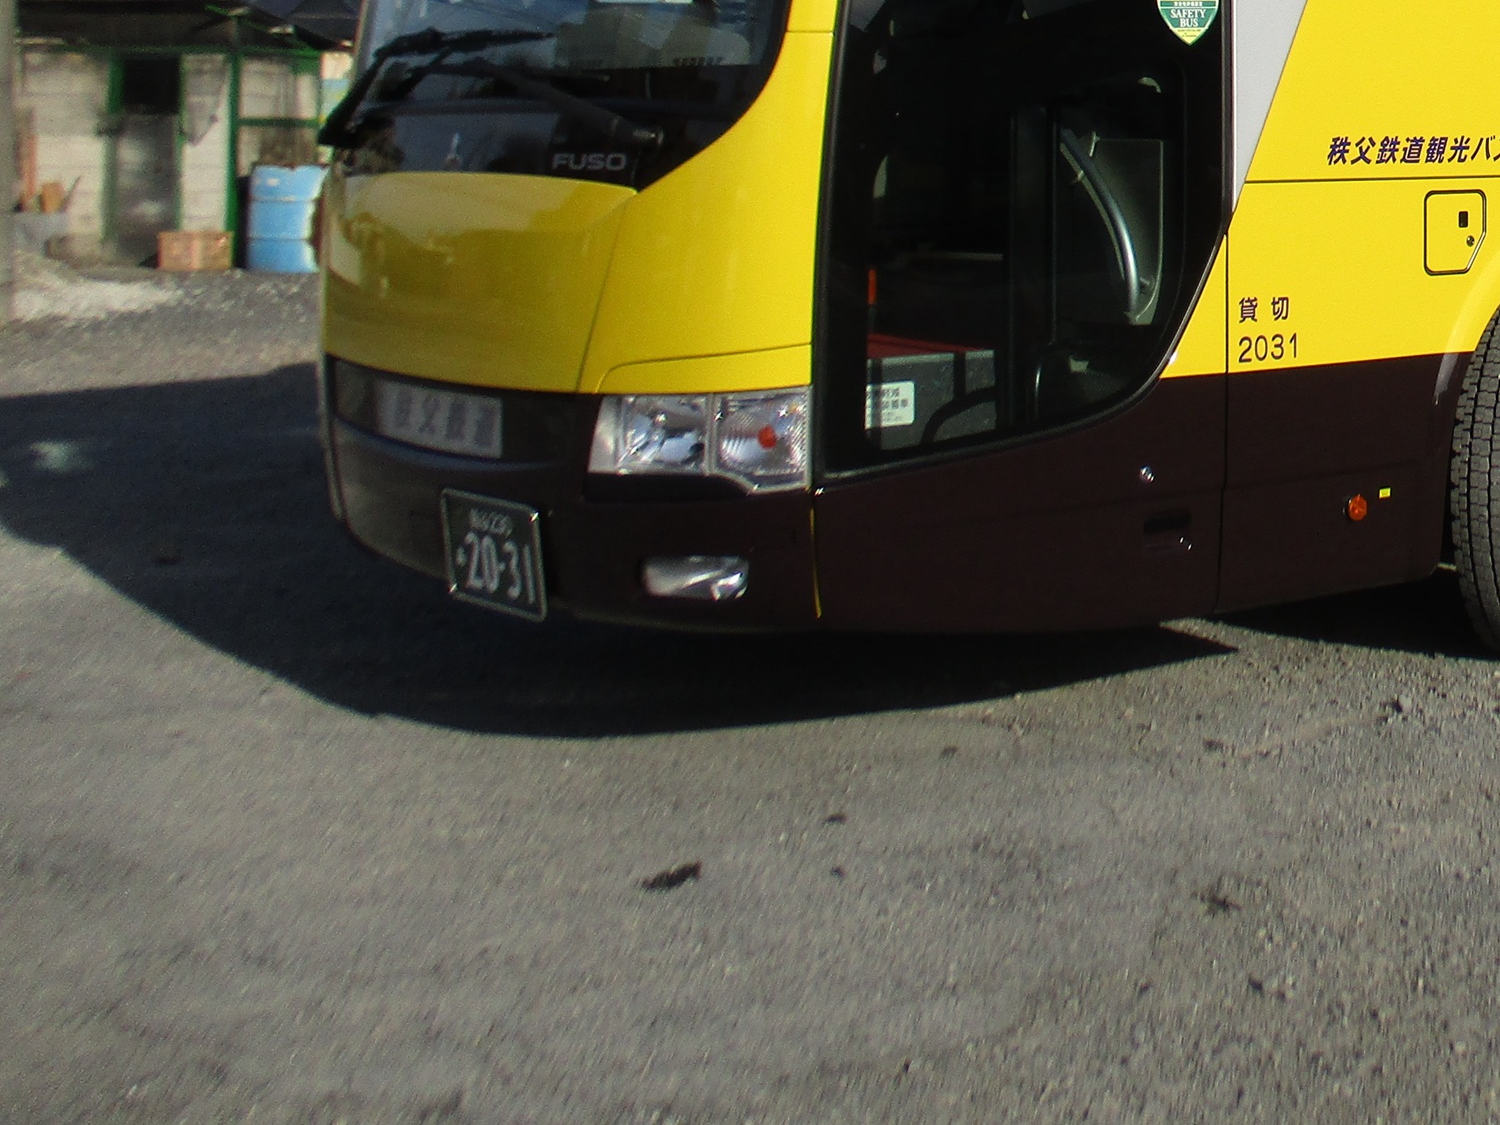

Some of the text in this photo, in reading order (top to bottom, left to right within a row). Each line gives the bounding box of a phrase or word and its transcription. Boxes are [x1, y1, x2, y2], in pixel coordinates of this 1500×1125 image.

[1170, 8, 1206, 19] SAFETY
[1180, 18, 1199, 28] BUS
[552, 153, 627, 171] FUSO
[1238, 296, 1290, 324] 貸切
[1238, 332, 1297, 364] 2031
